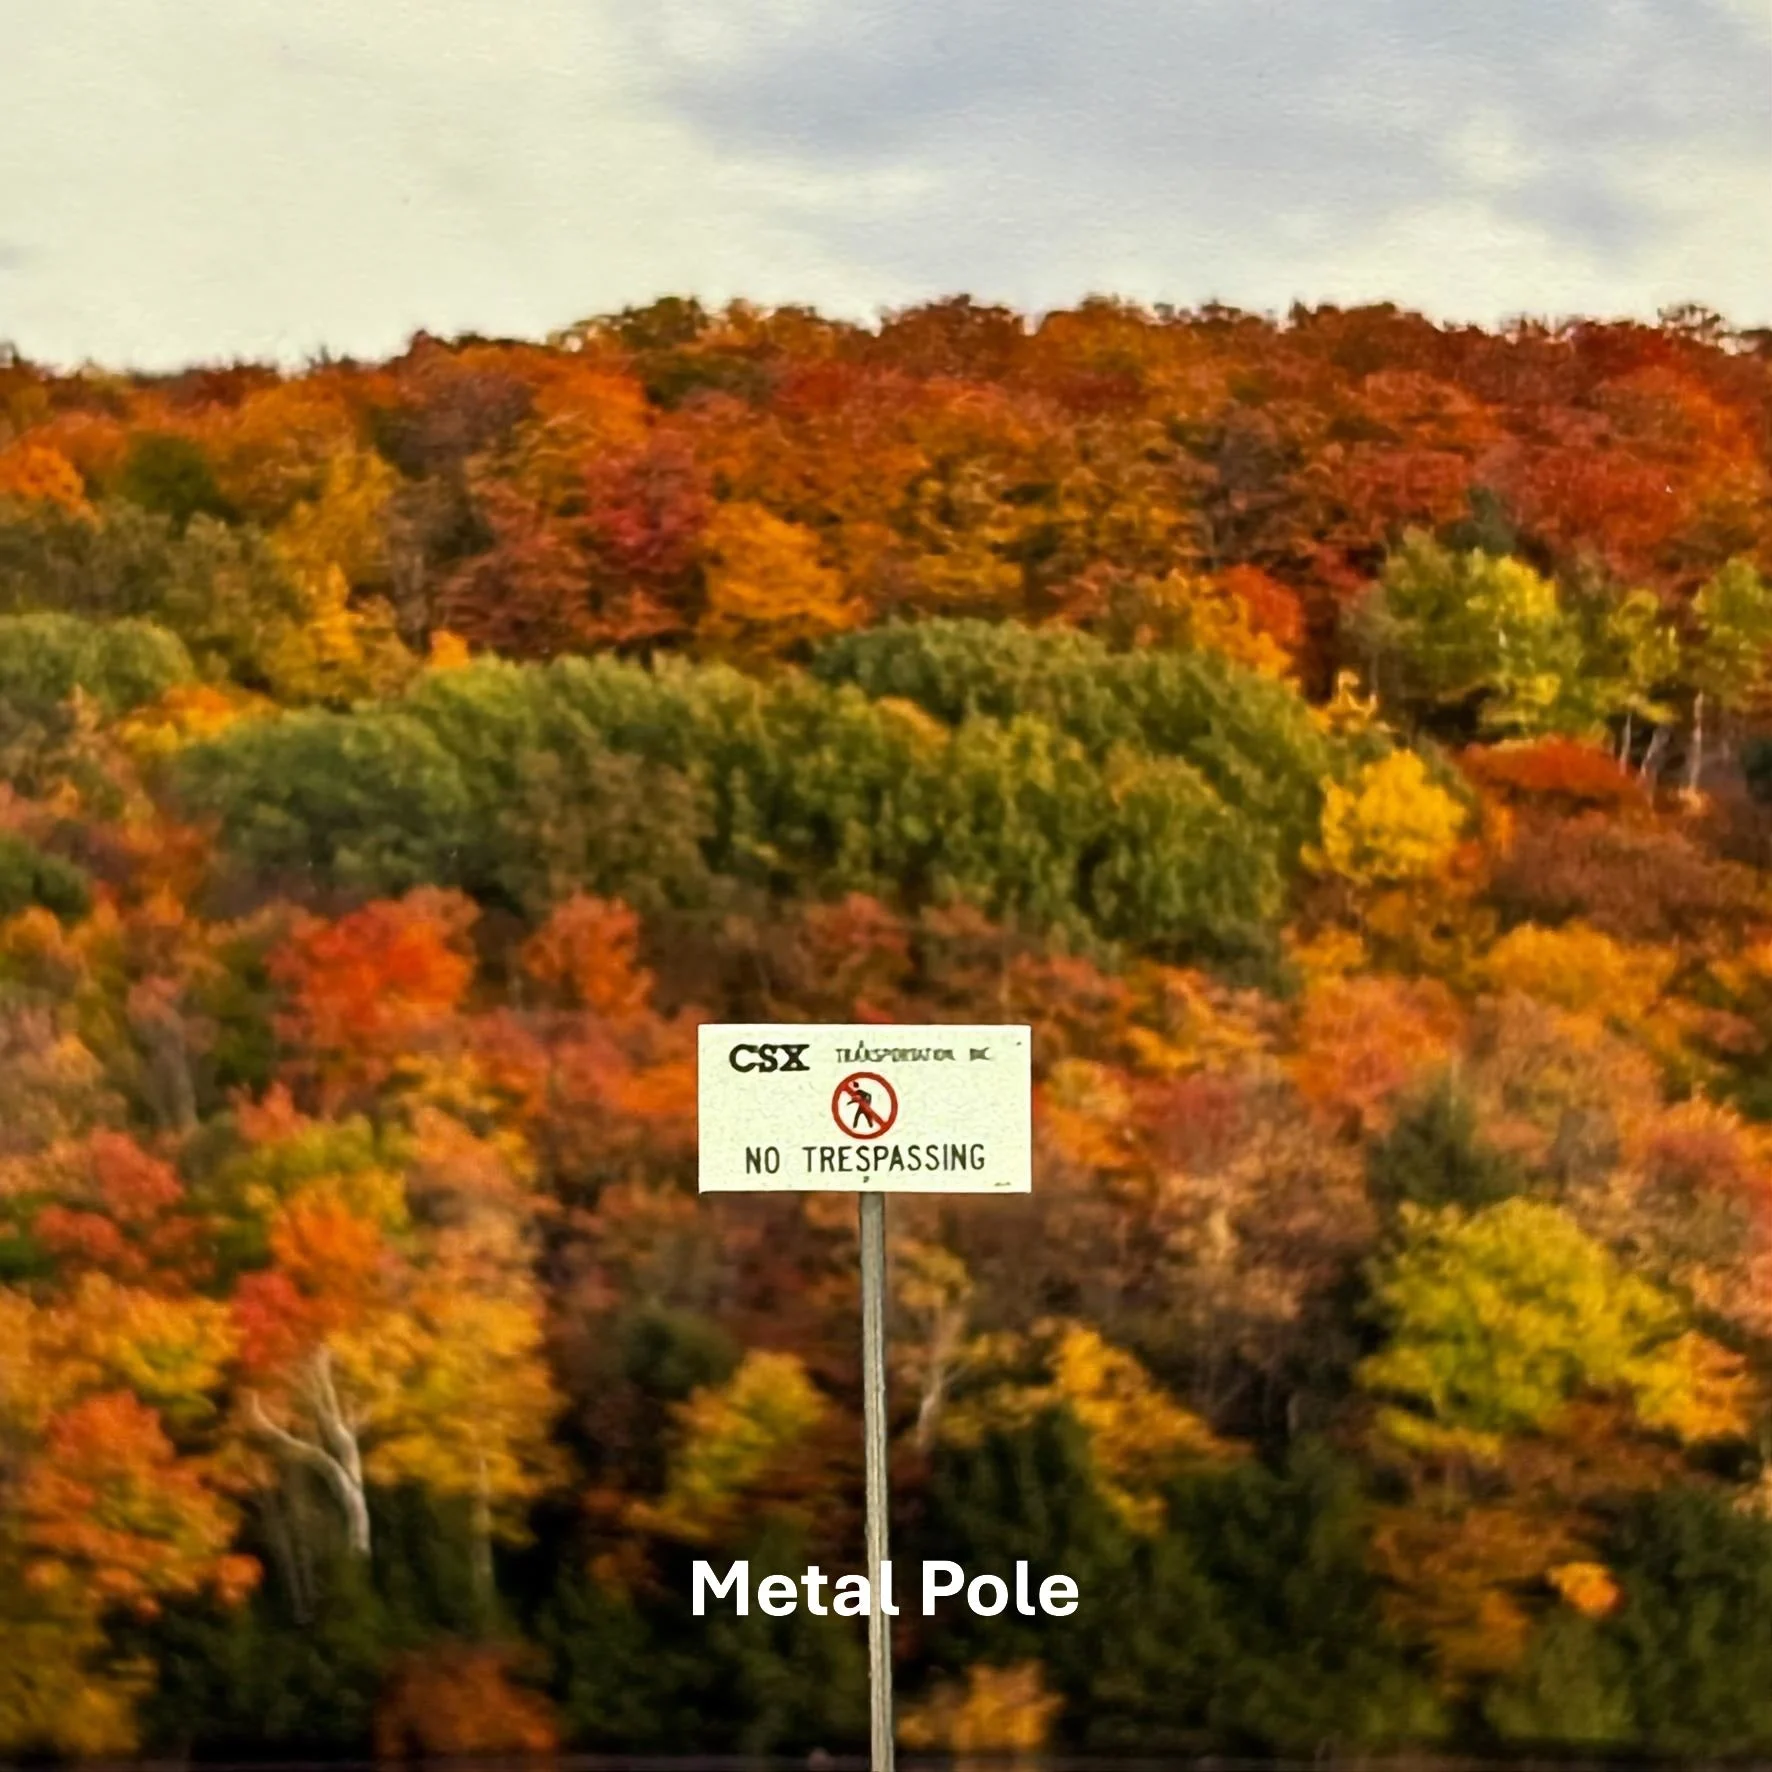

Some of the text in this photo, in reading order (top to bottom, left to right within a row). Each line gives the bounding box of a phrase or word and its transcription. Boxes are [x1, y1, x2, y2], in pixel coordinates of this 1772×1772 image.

[729, 1043, 810, 1073] CSX
[745, 1144, 986, 1174] NO TRESPASSING
